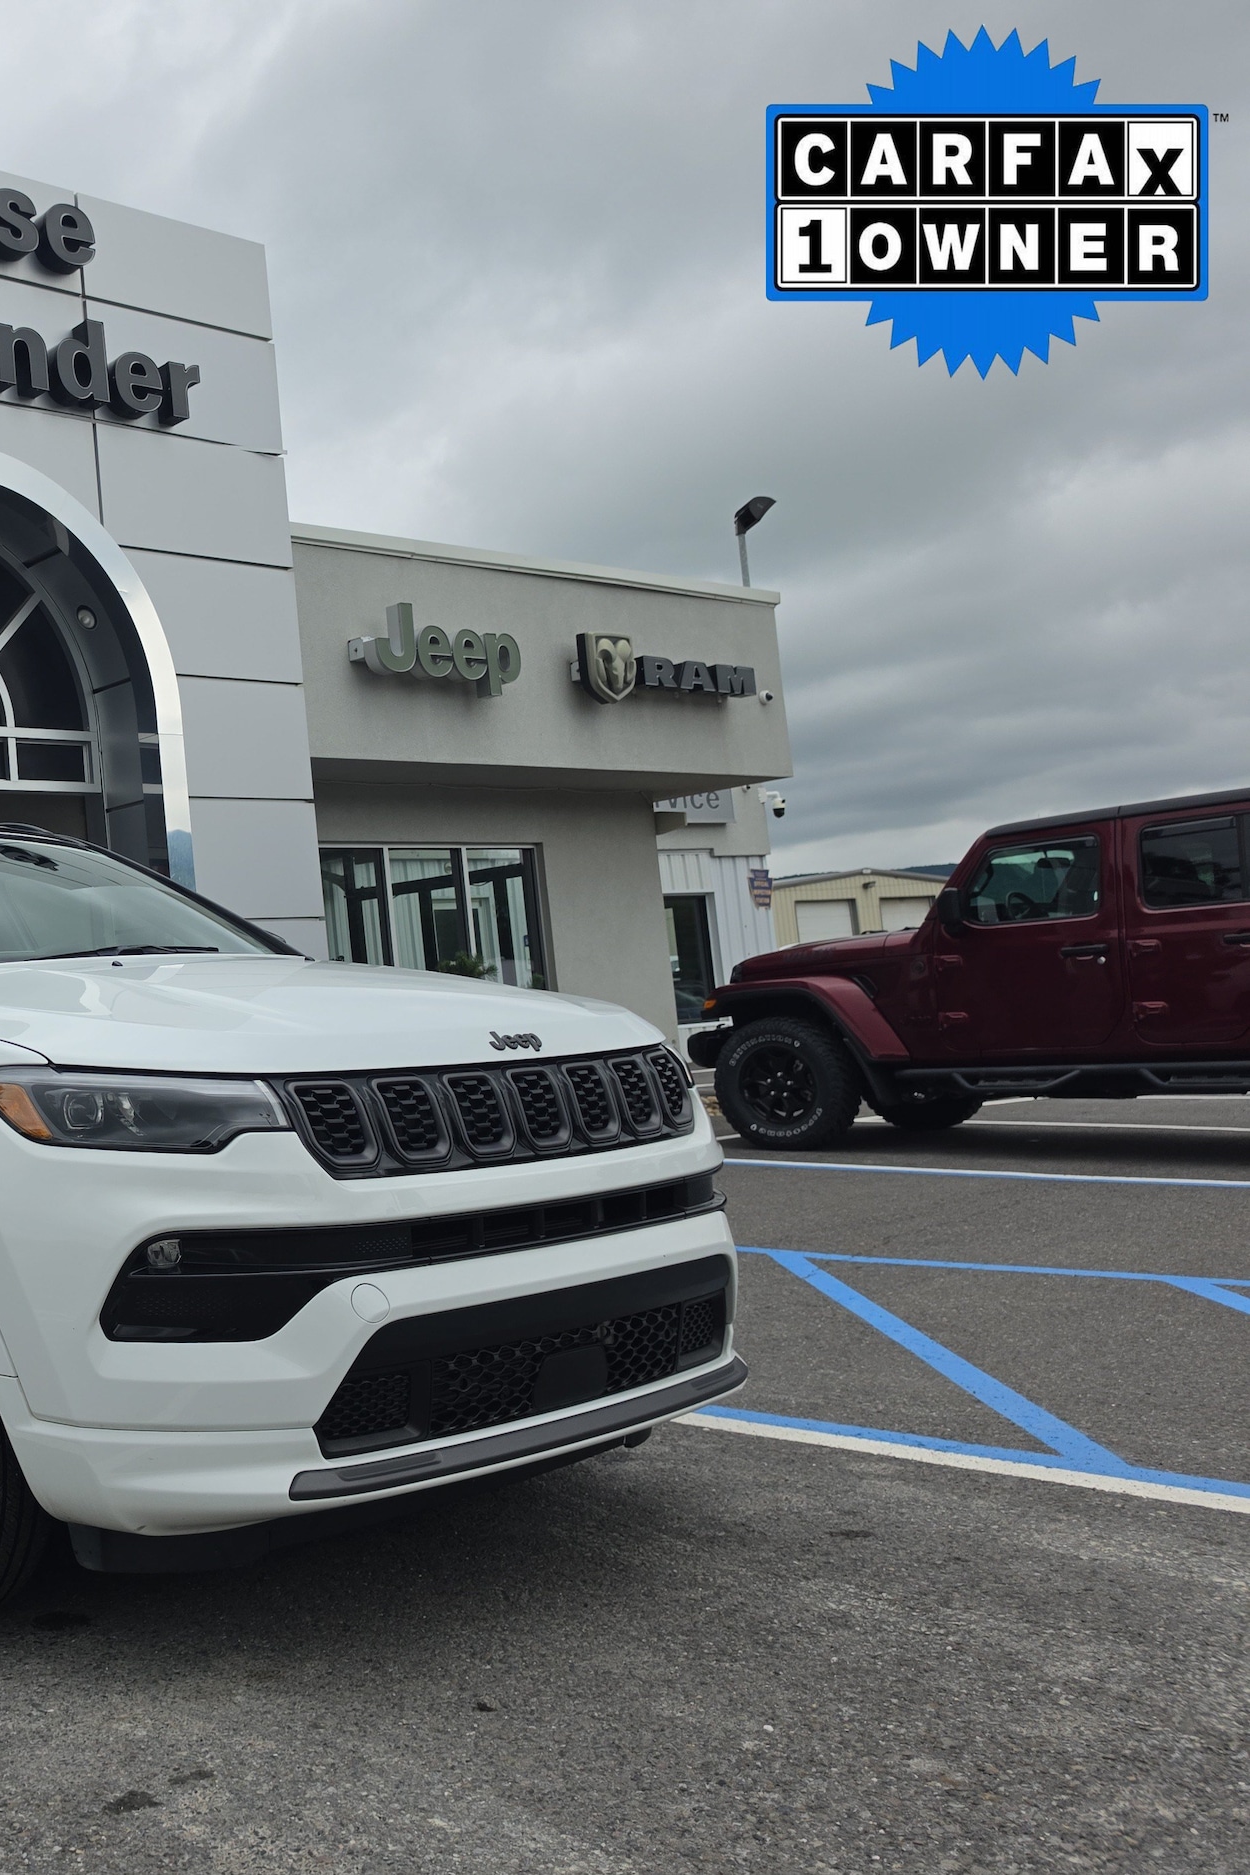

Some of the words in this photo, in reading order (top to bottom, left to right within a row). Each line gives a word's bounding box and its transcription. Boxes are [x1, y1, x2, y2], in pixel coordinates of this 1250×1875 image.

[363, 602, 521, 698] Jeep
[636, 655, 757, 697] RAM
[489, 1031, 543, 1052] Jeep
